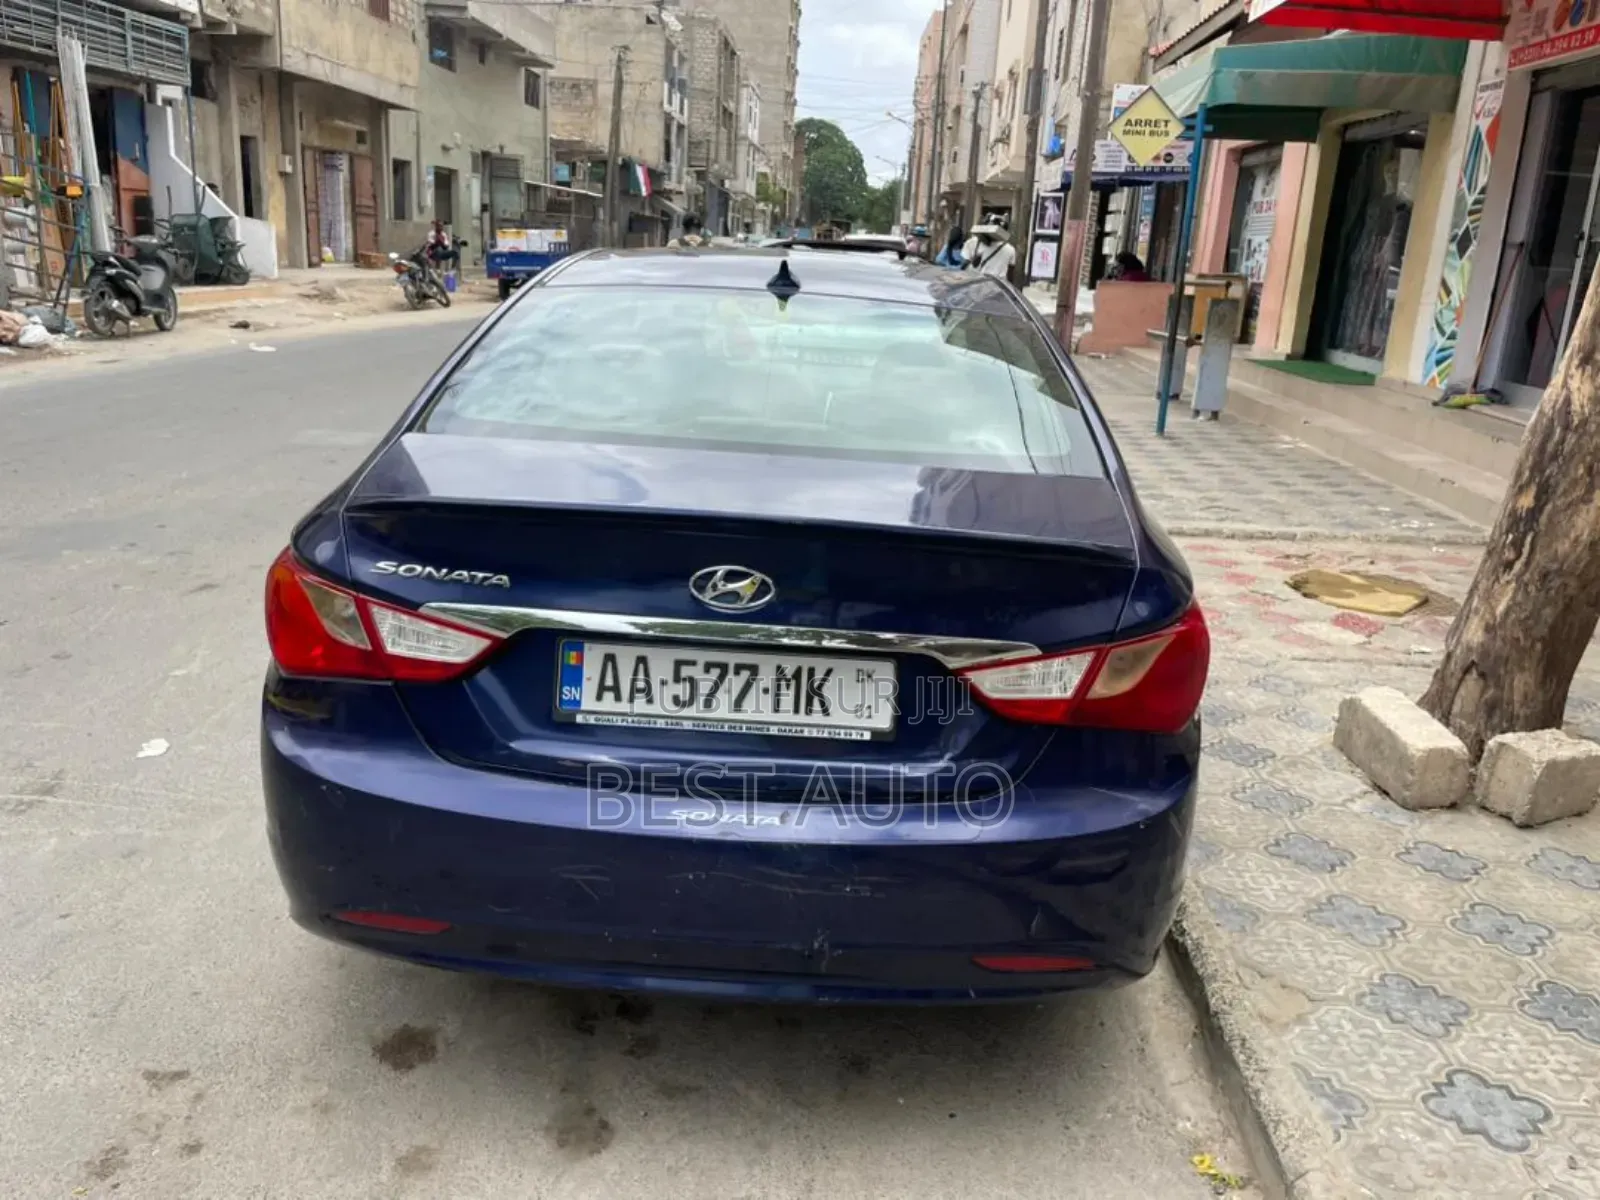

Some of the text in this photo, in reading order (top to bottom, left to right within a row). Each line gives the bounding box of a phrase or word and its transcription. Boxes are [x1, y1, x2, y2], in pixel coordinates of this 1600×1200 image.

[1124, 118, 1171, 128] ARRET
[369, 560, 511, 588] SONATA
[562, 686, 581, 701] SN
[667, 808, 782, 827] SONATA
